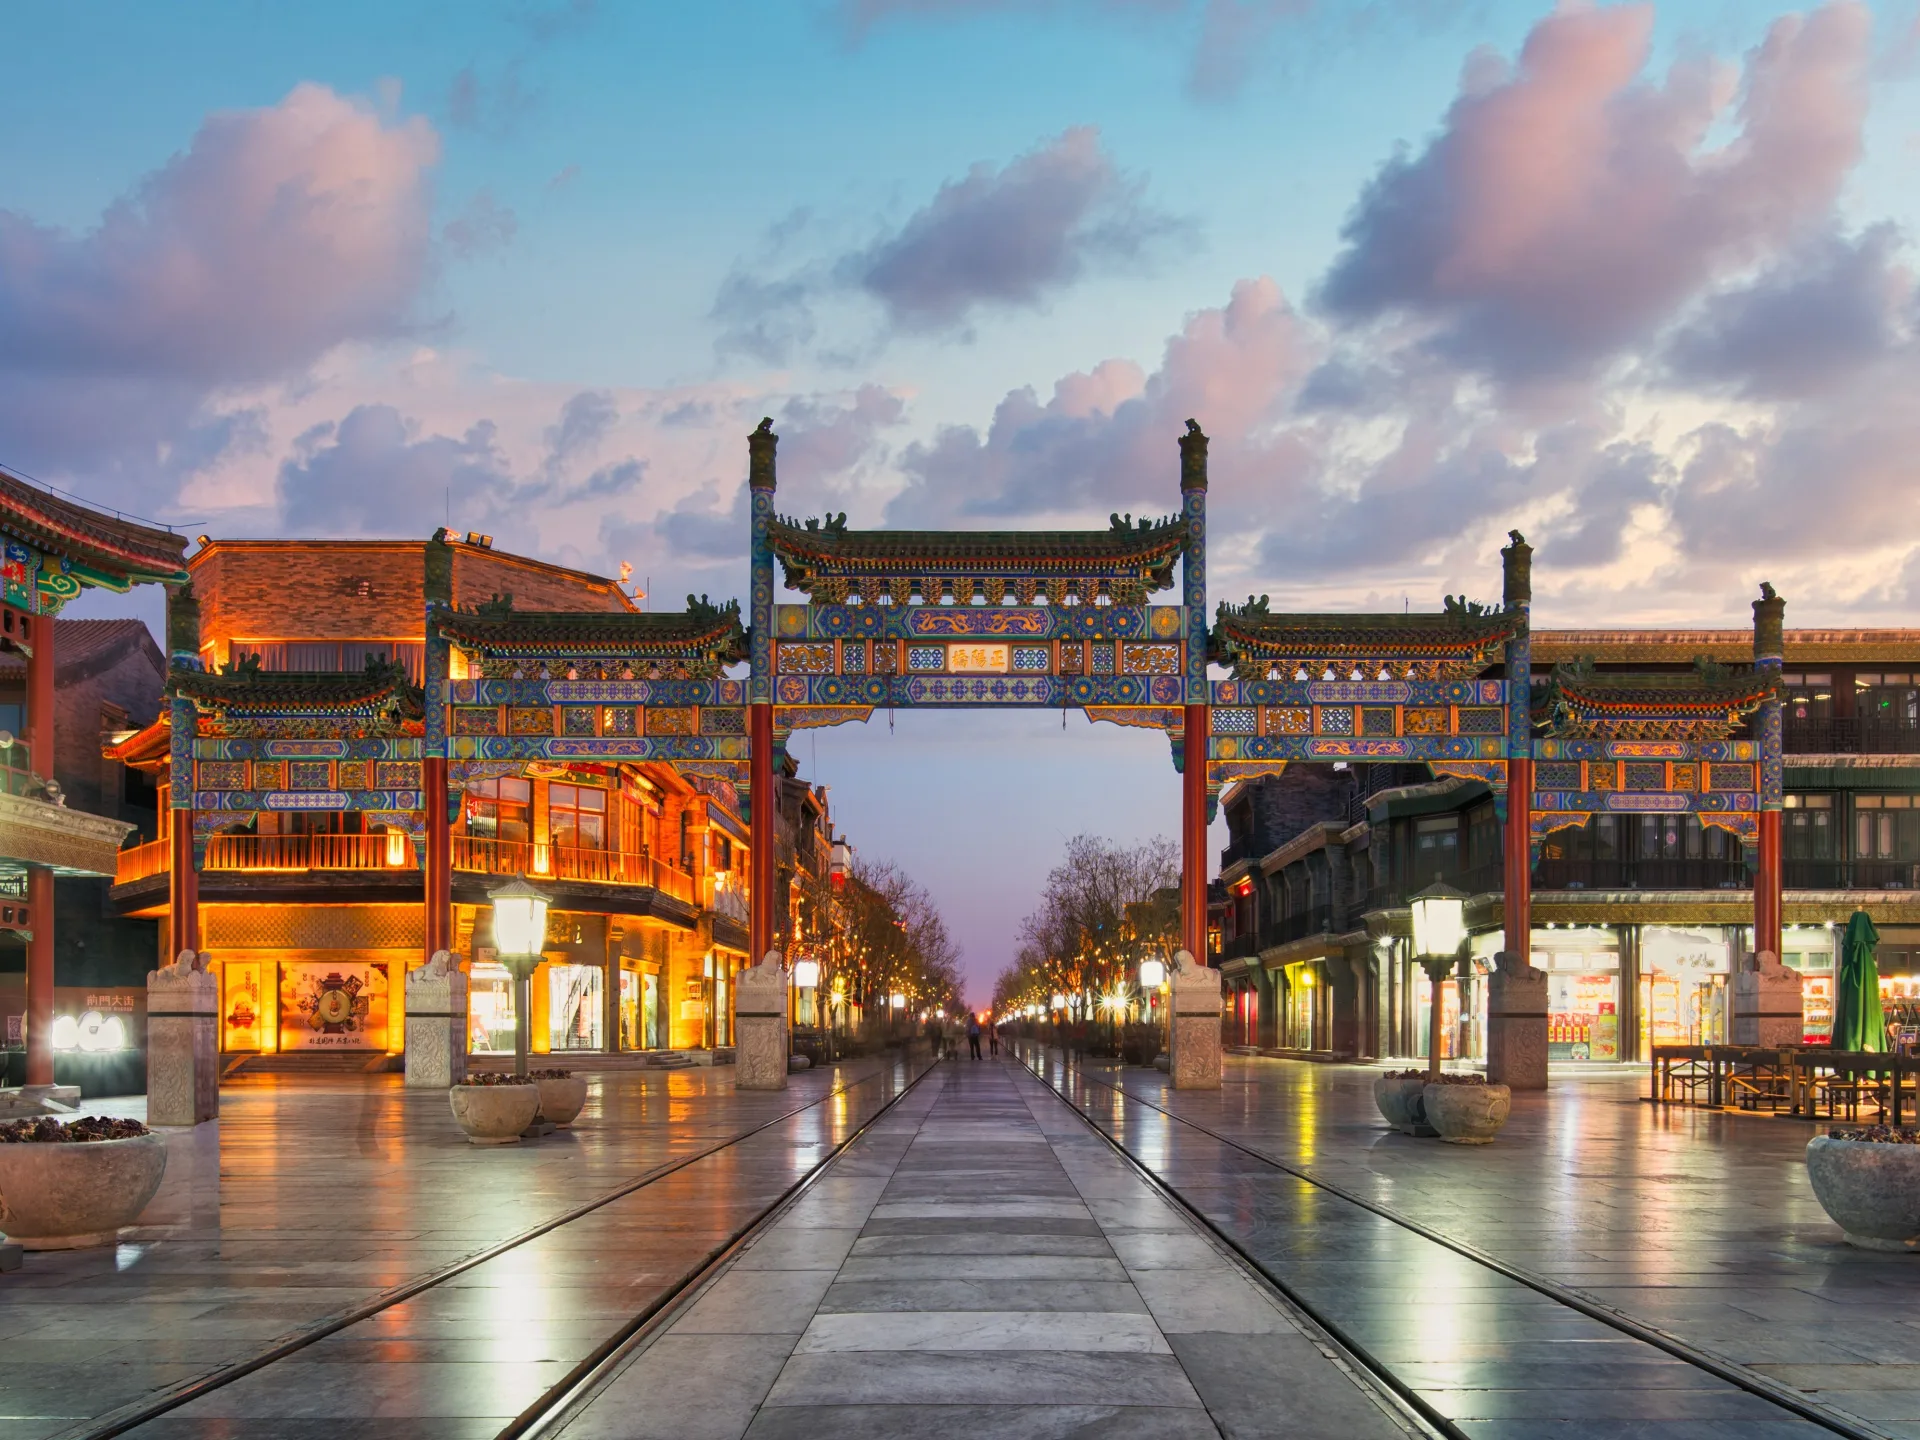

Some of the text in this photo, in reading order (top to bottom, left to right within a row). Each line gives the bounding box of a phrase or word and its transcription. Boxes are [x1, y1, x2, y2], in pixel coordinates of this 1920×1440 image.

[951, 648, 1005, 669] 正陽橋
[86, 994, 135, 1007] 前門大街
